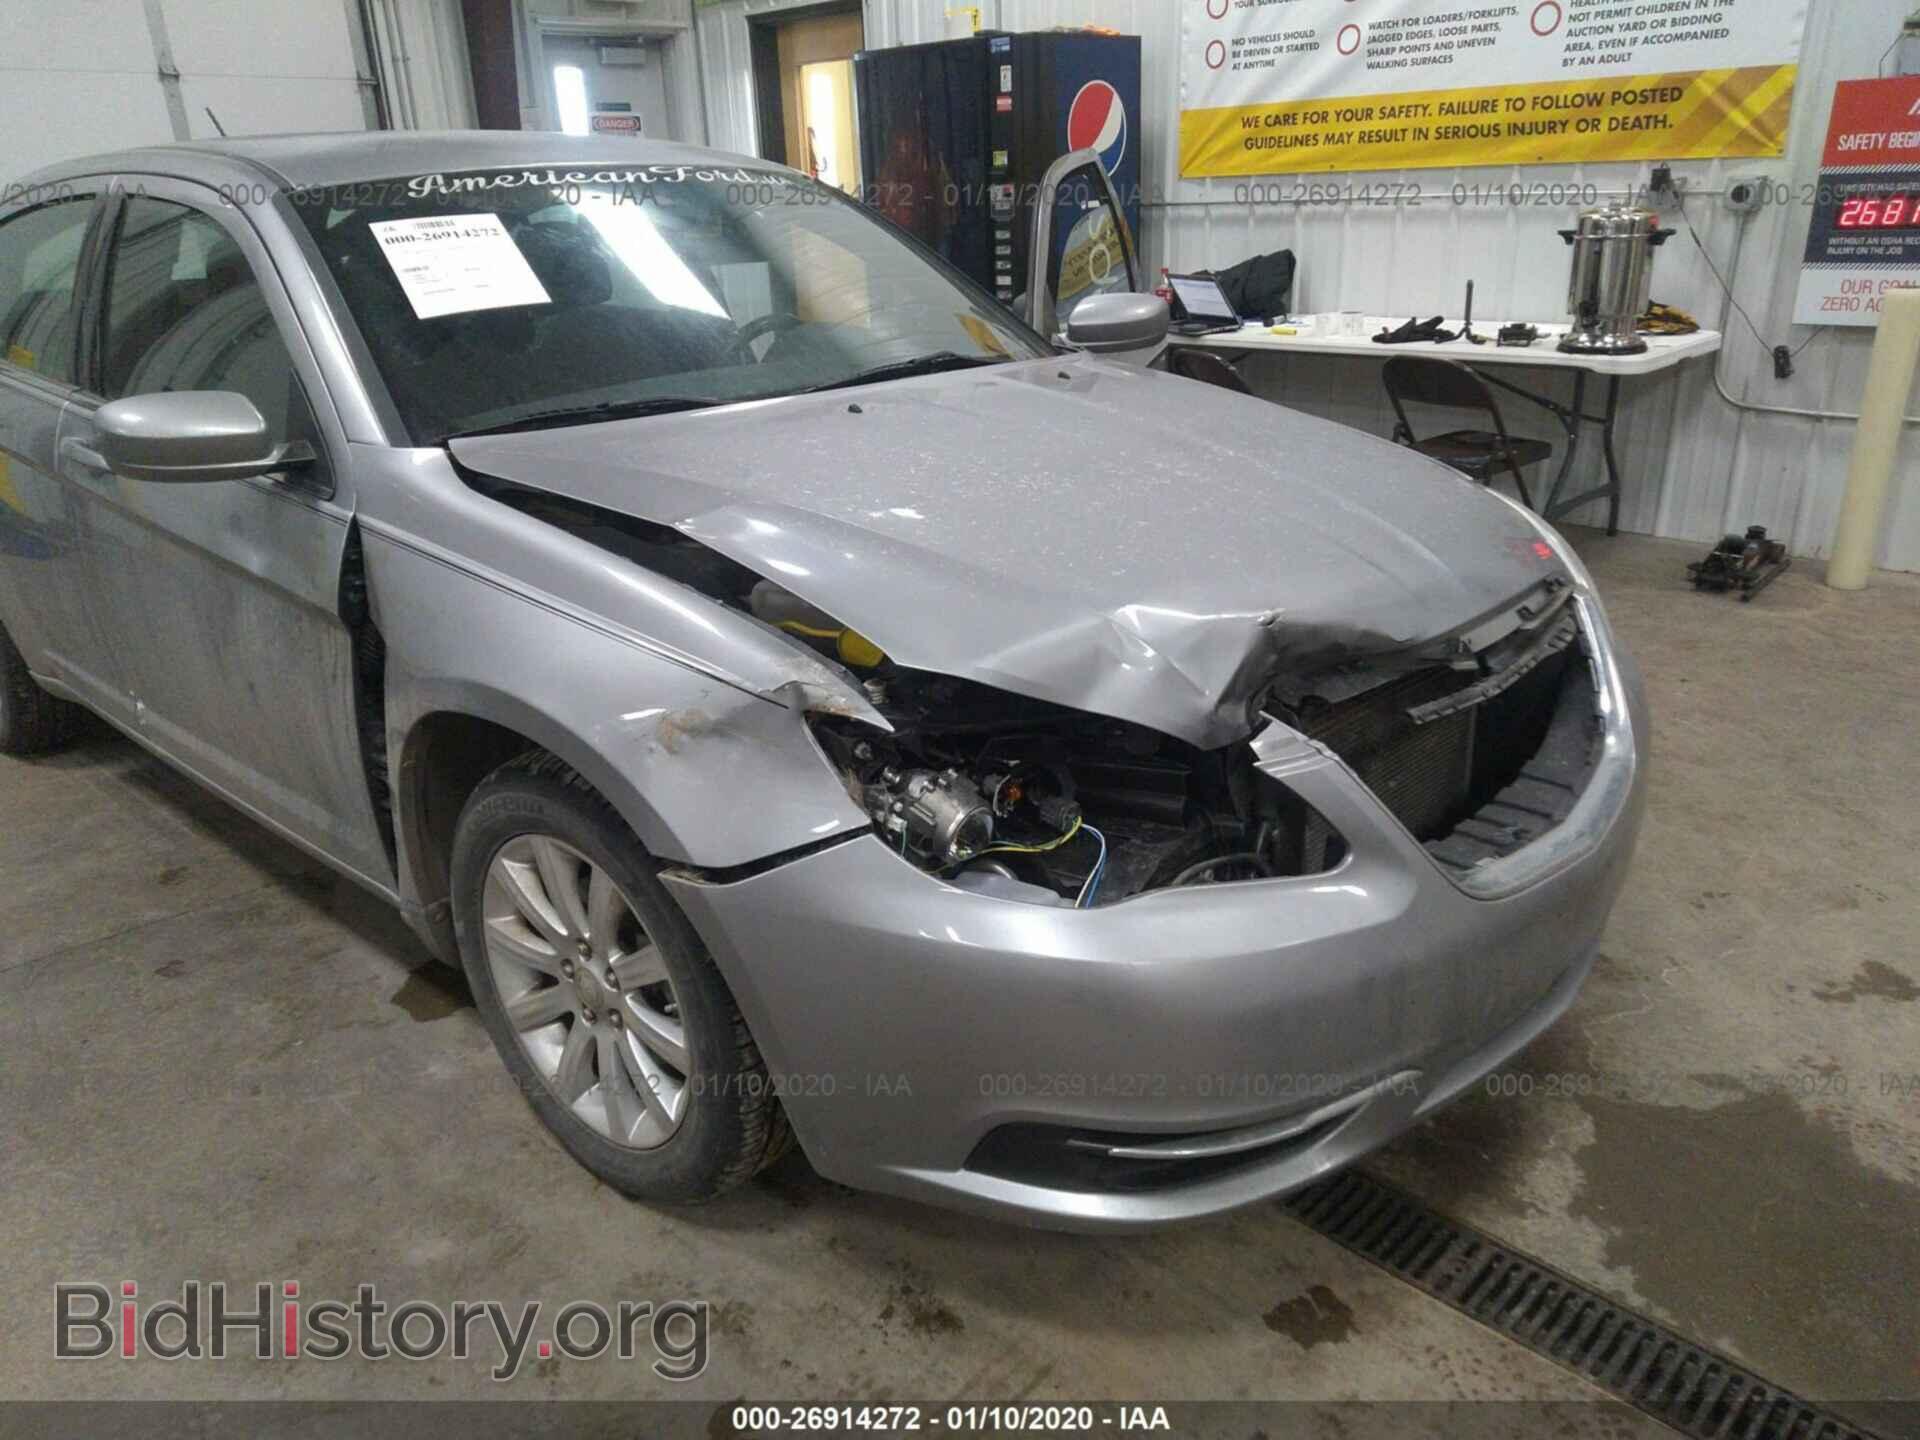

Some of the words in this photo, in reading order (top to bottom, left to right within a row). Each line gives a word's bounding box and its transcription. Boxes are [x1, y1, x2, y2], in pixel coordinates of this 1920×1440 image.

[1568, 12, 1590, 23] NOT
[1594, 7, 1632, 21] PERMIT
[1635, 1, 1691, 16] CHILDREN
[1369, 18, 1399, 30] WATCH
[1402, 18, 1420, 27] FOR
[1566, 25, 1614, 38] AUCTION
[1618, 21, 1647, 32] YARD
[1650, 19, 1667, 29] OR
[1671, 13, 1723, 27] BIDDING
[1232, 38, 1246, 46] NO
[1248, 34, 1281, 45] VEHICLES
[1283, 30, 1316, 40] SHOULD
[1367, 32, 1403, 44] JAGGED
[1439, 26, 1468, 37] LOOSE
[1597, 37, 1630, 50] EVEN
[1629, 36, 1638, 46] IF
[1641, 28, 1730, 46] ACCOMPANIED
[1243, 47, 1270, 57] DRIVEN
[1273, 45, 1284, 53] OR
[1286, 42, 1320, 53] STARTED
[1367, 45, 1396, 57] SHARP
[1399, 42, 1431, 54] POINTS
[1434, 41, 1454, 51] AND
[1457, 36, 1496, 49] UNEVEN
[1366, 58, 1408, 70] WALKING
[1410, 54, 1454, 66] SURFACES
[1562, 57, 1576, 67] BY
[1578, 55, 1596, 66] AN
[1597, 52, 1633, 65] ADULT
[1242, 115, 1261, 128] WE
[1264, 112, 1298, 127] CARE
[1302, 110, 1329, 124] FOR
[1334, 108, 1373, 122] YOUR
[1378, 103, 1432, 121] SAFETY.
[1438, 98, 1499, 116] FAILURE
[1505, 96, 1526, 113] TO
[1531, 92, 1605, 111] FOLLOW
[1610, 86, 1684, 106] POSTED
[1244, 133, 1319, 150] GUIDELINES
[1323, 131, 1353, 146] MAY
[1358, 128, 1409, 144] RESULT
[1412, 127, 1430, 141] IN
[1434, 123, 1501, 141] SERIOUS
[1507, 119, 1569, 136] INJURY
[1575, 117, 1601, 133] OR
[1607, 113, 1673, 132] DEATH.
[1838, 133, 1887, 151] SAFETY
[384, 228, 500, 245] 000-26914272
[1840, 279, 1873, 294] OUR
[1821, 296, 1860, 312] ZERO
